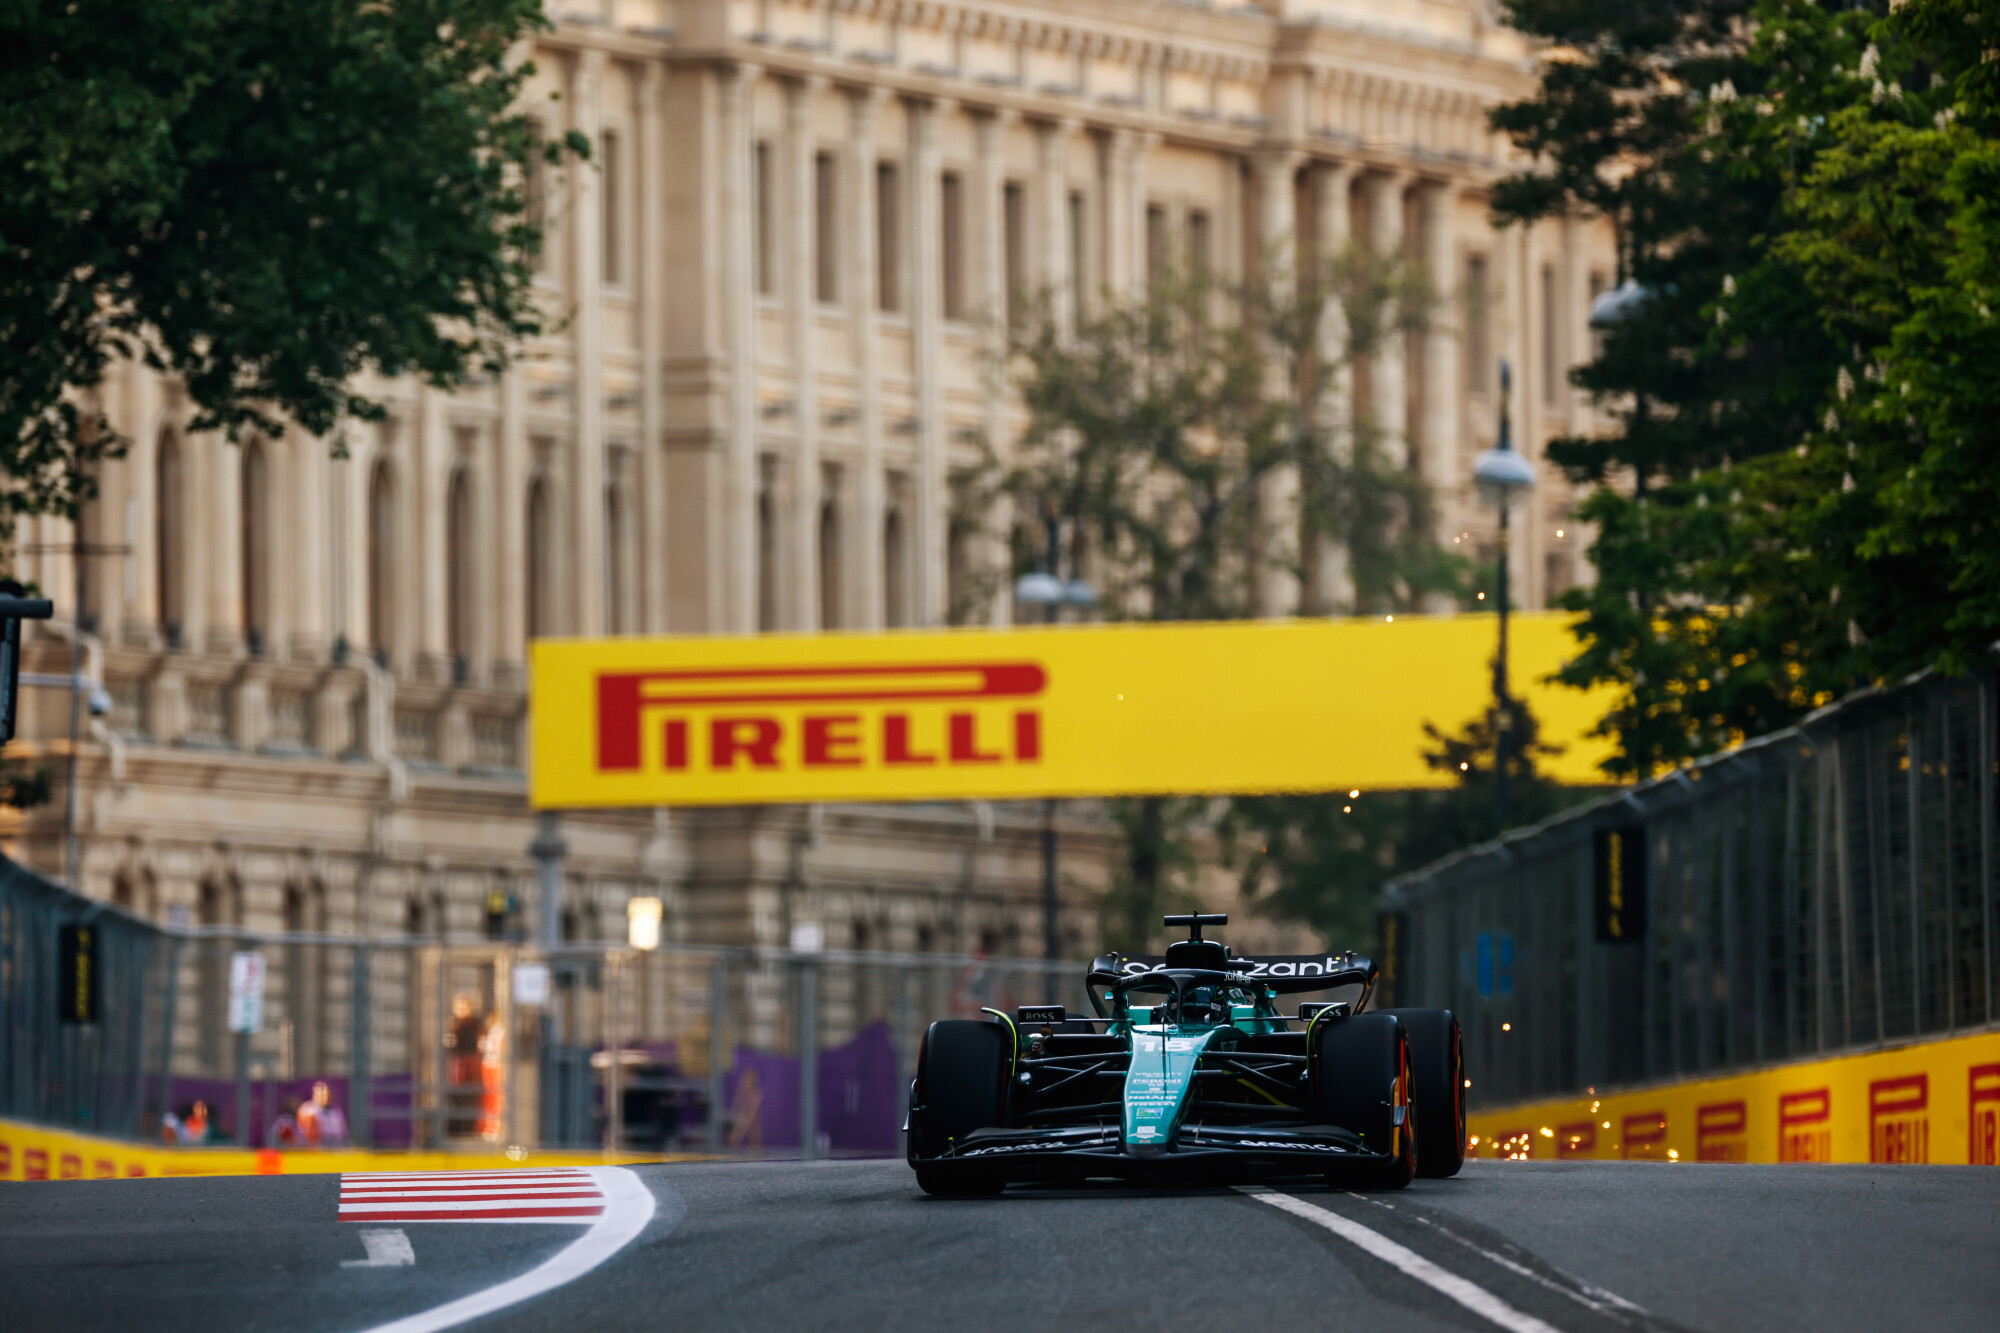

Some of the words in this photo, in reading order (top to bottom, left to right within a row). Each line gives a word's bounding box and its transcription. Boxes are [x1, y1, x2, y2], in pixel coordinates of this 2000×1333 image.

[596, 662, 1047, 771] PIRELLI
[1123, 957, 1339, 976] czant
[1025, 1012, 1055, 1020] BOSS
[1310, 1008, 1342, 1017] BSS
[1140, 1041, 1192, 1052] 18
[1239, 1139, 1347, 1153] aramco
